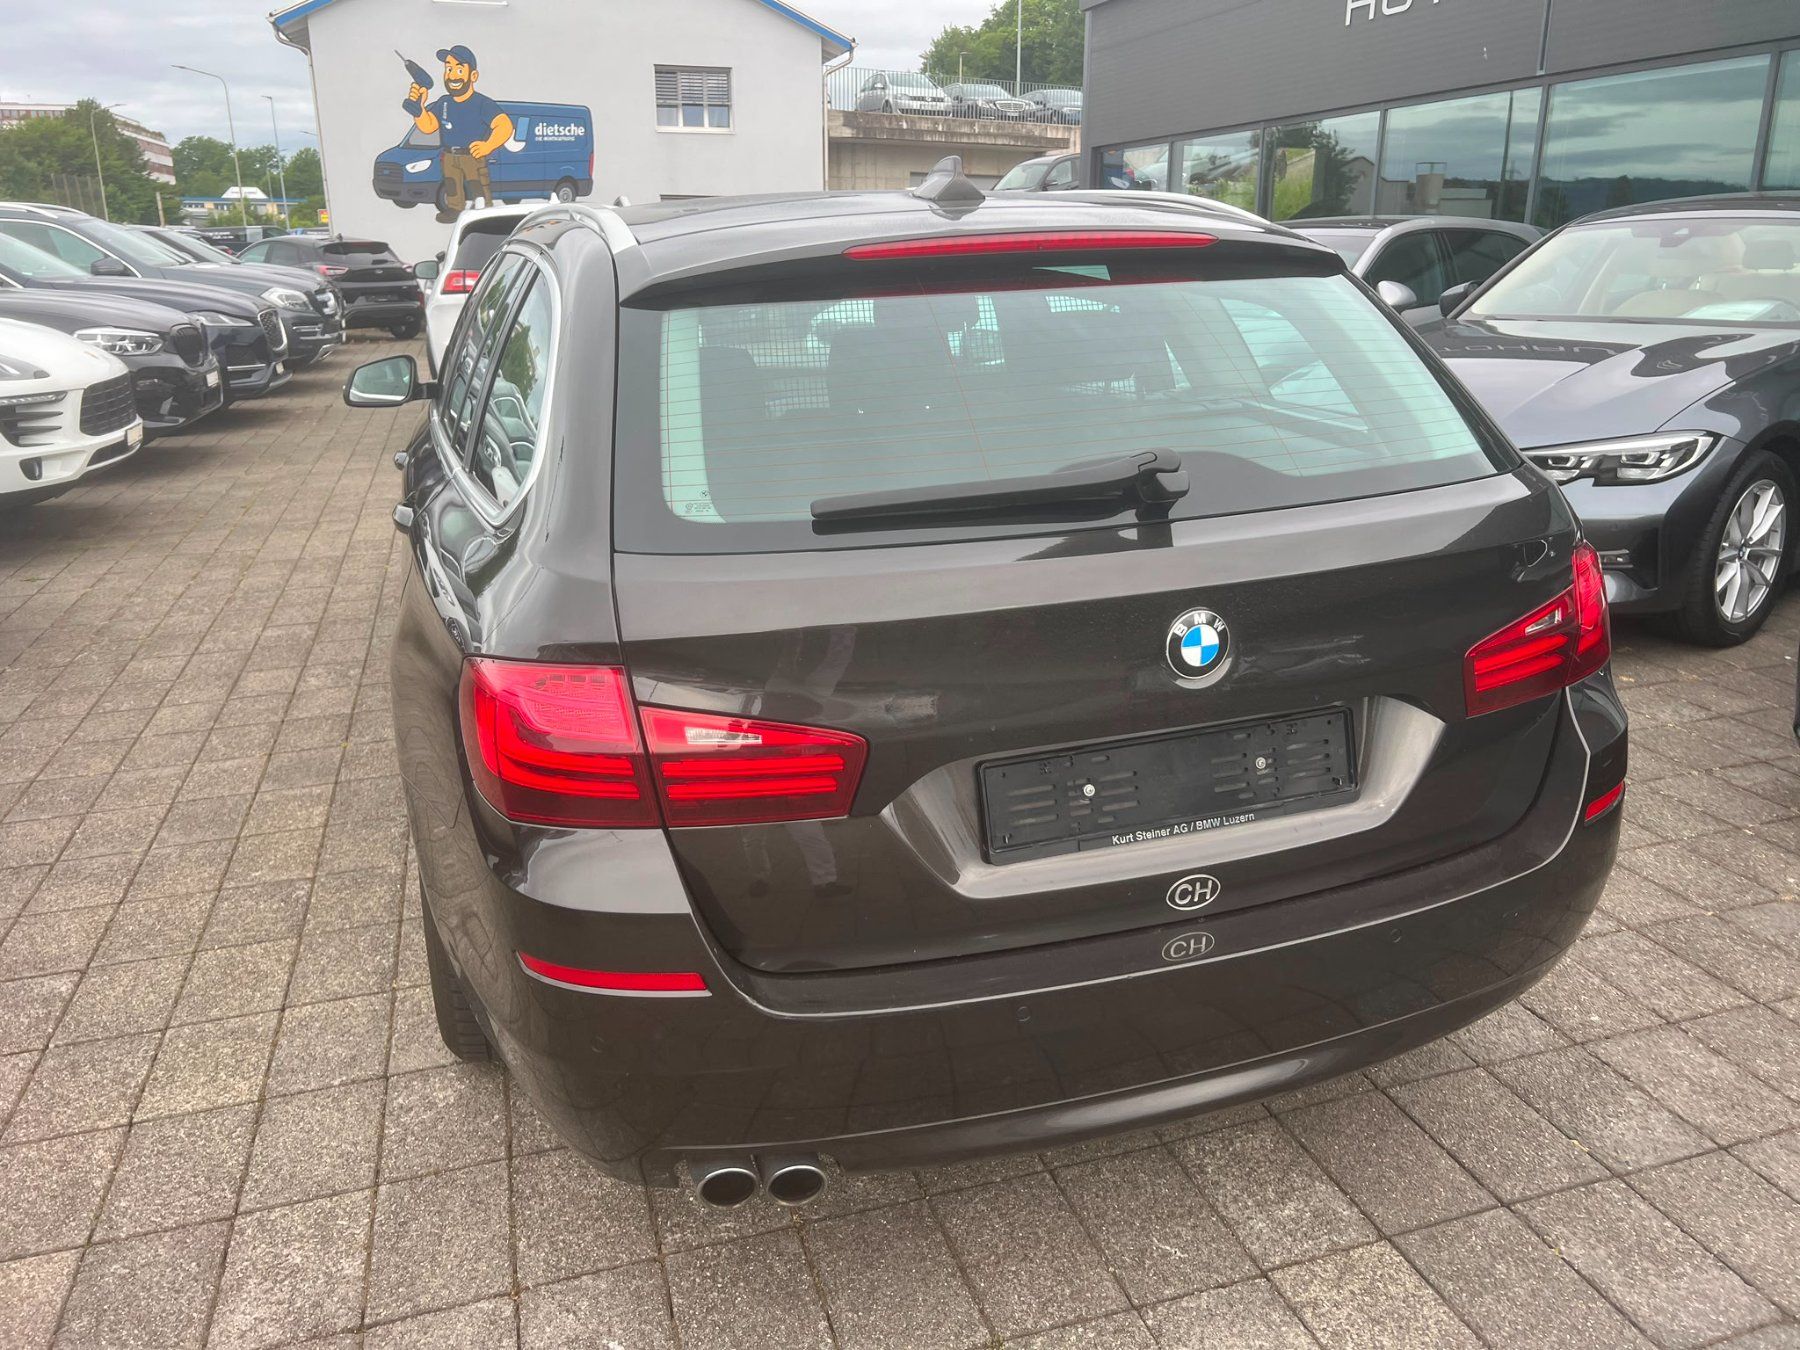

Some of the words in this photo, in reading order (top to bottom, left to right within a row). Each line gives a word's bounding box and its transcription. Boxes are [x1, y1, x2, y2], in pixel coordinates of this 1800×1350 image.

[535, 123, 585, 135] dietsche
[1174, 613, 1225, 638] BMW
[1112, 833, 1134, 845] Kurt
[1136, 827, 1171, 841] Steiner
[1173, 823, 1188, 835] AG
[1196, 817, 1221, 831] BMW
[1223, 812, 1255, 826] Luzern
[1174, 880, 1213, 905] CH
